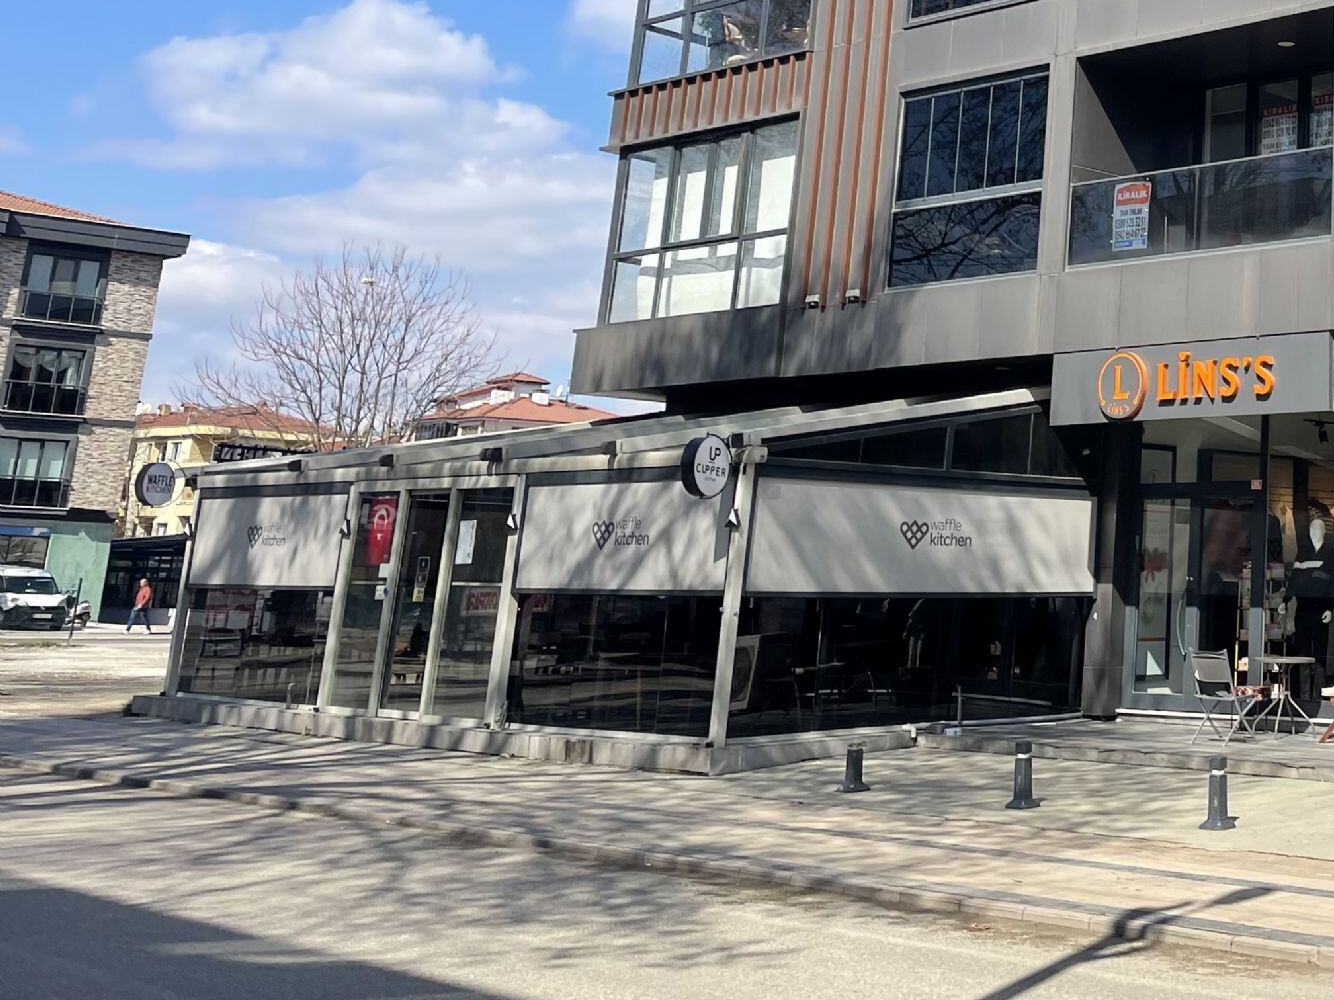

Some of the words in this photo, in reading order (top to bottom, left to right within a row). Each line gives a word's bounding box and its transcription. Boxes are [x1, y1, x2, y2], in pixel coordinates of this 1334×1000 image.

[1113, 365, 1129, 399] L
[696, 463, 726, 477] CUPPER
[148, 474, 173, 487] WAFFLE
[615, 516, 642, 530] waffle
[930, 518, 962, 532] waffle
[614, 531, 650, 546] kitchen
[930, 532, 972, 547] kitchen
